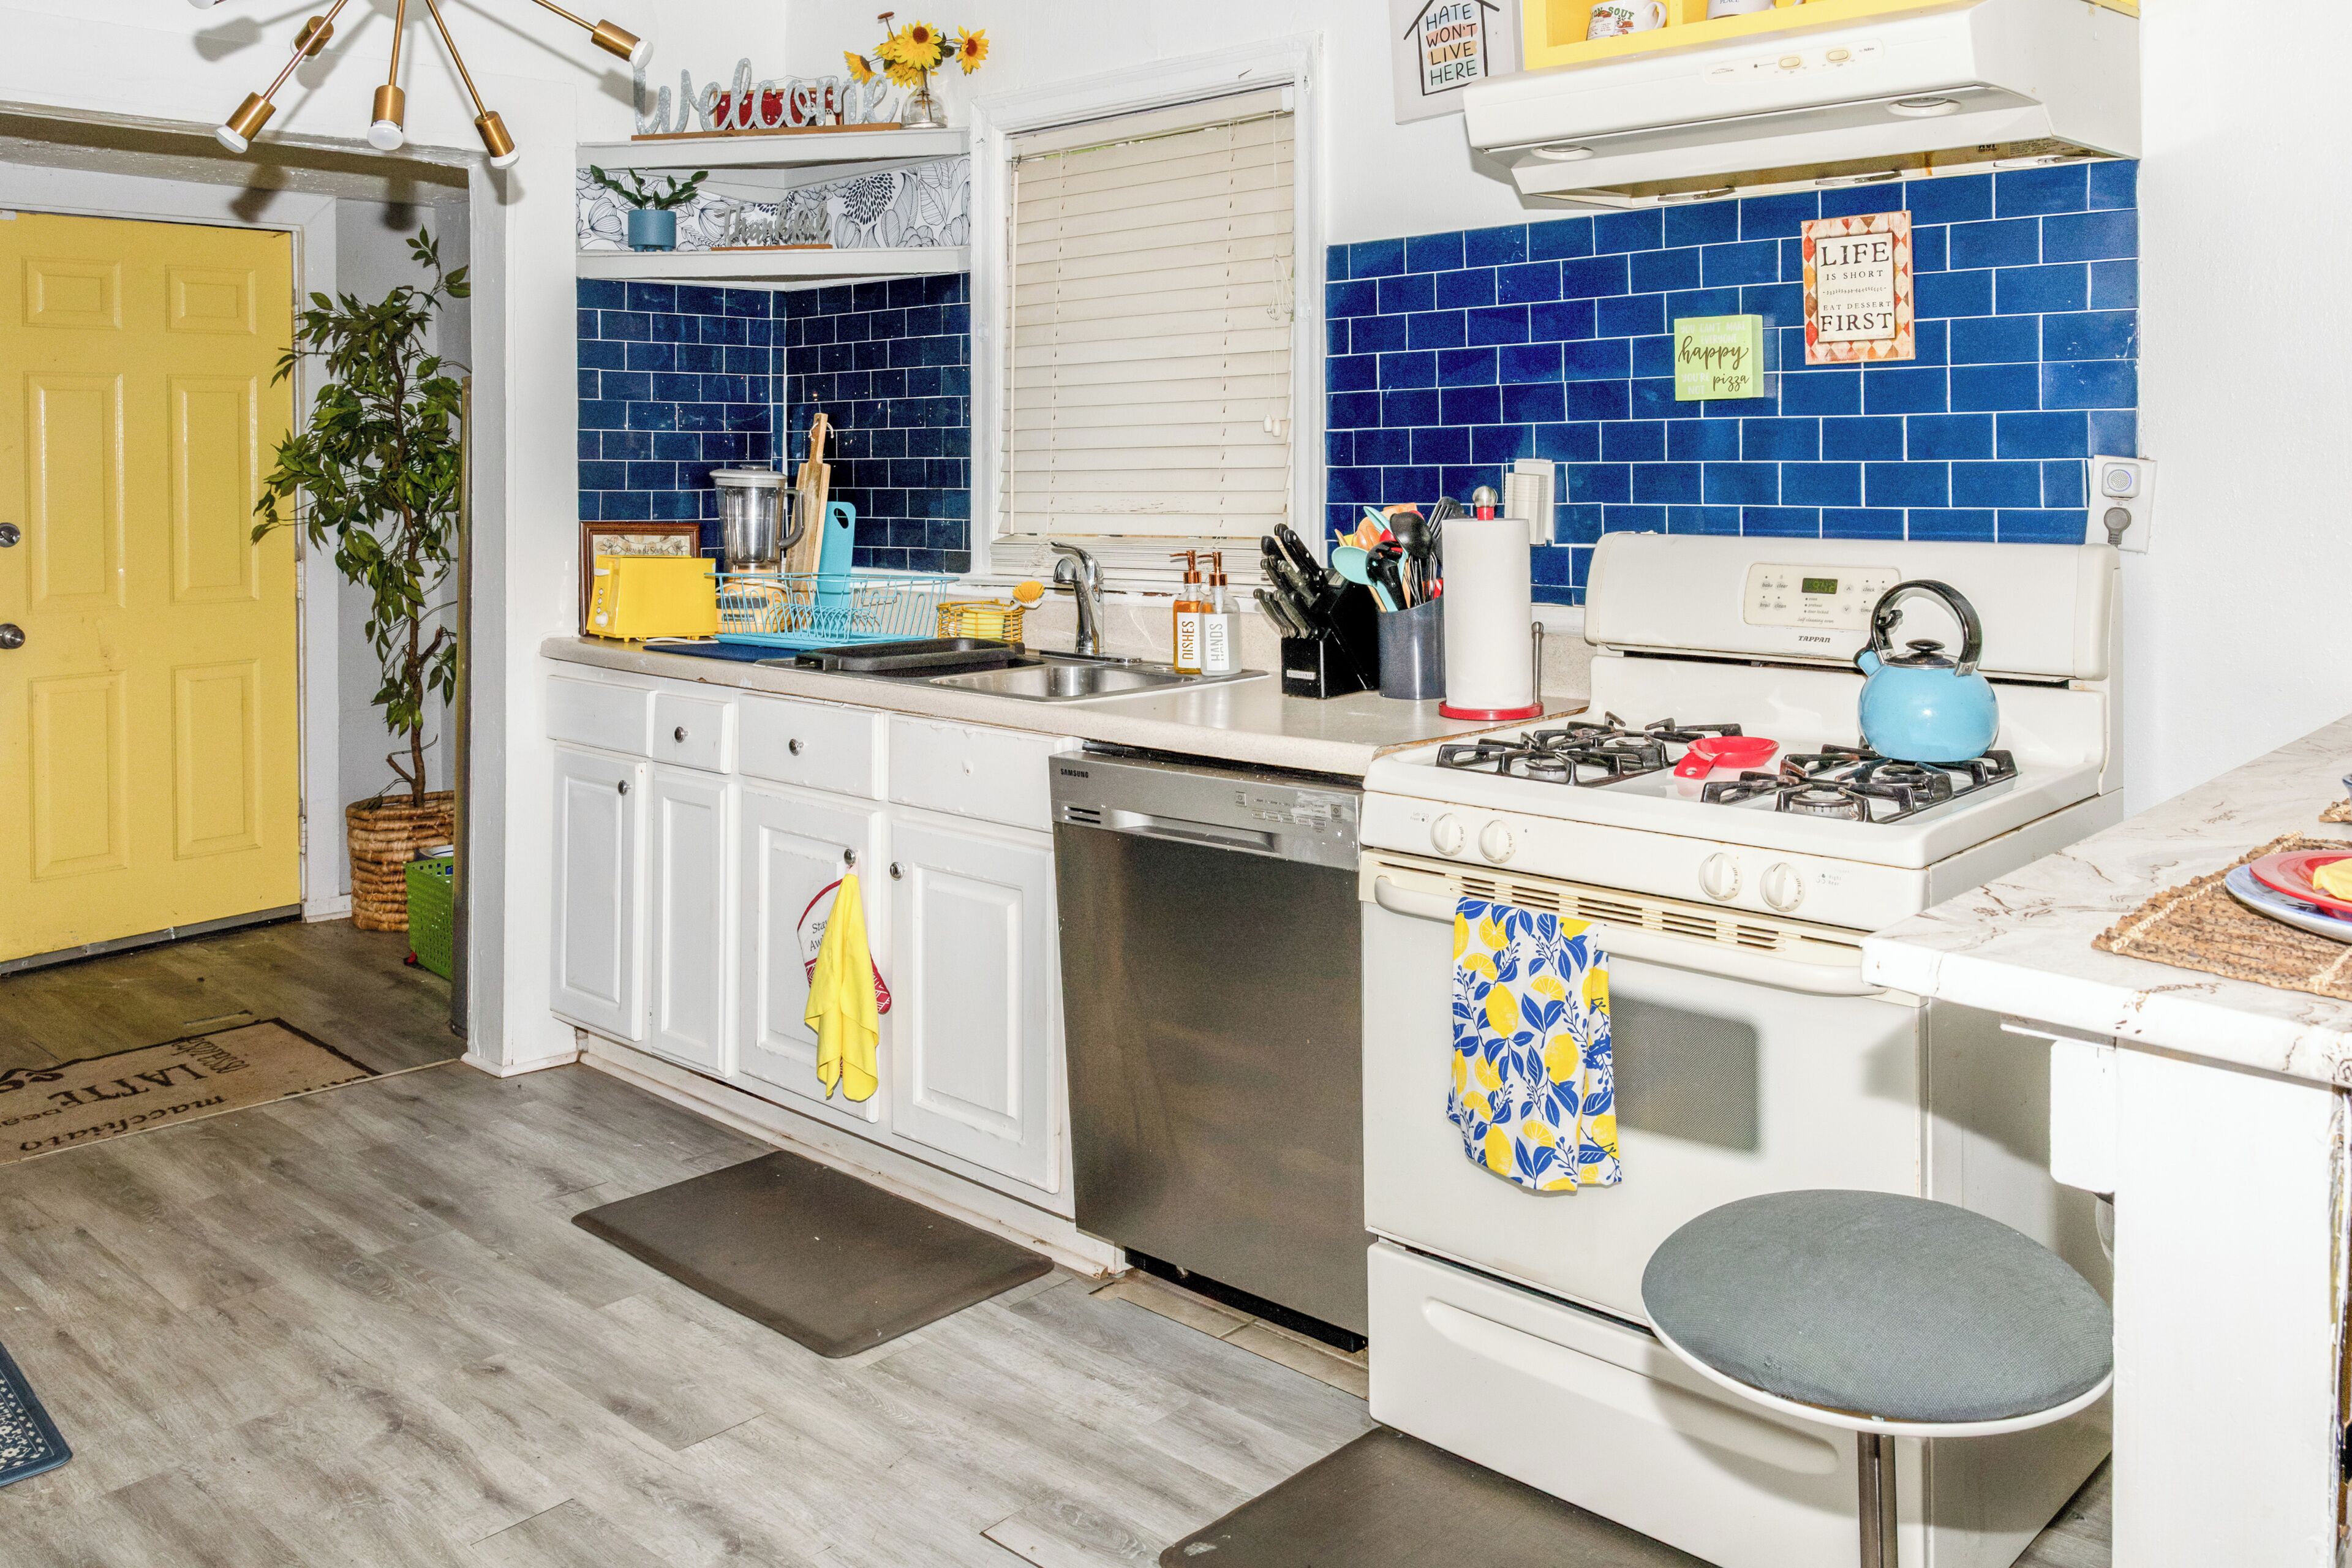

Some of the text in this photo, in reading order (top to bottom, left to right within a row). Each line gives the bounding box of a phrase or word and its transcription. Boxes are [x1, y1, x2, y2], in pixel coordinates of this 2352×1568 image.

[1426, 2, 1472, 31] HATE
[1426, 23, 1477, 48] WON'T
[1430, 41, 1472, 66] LIVE
[1430, 59, 1478, 86] HERE
[1820, 241, 1890, 267] LIFE
[1843, 270, 1883, 279] SHORT
[1847, 301, 1891, 310] DESSERT
[1820, 312, 1893, 332] FIRST
[1678, 335, 1749, 371] happy
[1687, 385, 1705, 395] NOT
[1713, 373, 1750, 392] pizza
[1182, 621, 1194, 660] DISHES
[1209, 624, 1224, 662] HANDS
[1060, 767, 1089, 779] SAMSUNG
[47, 1063, 208, 1107] LATTE
[20, 1094, 229, 1152] macchiato
